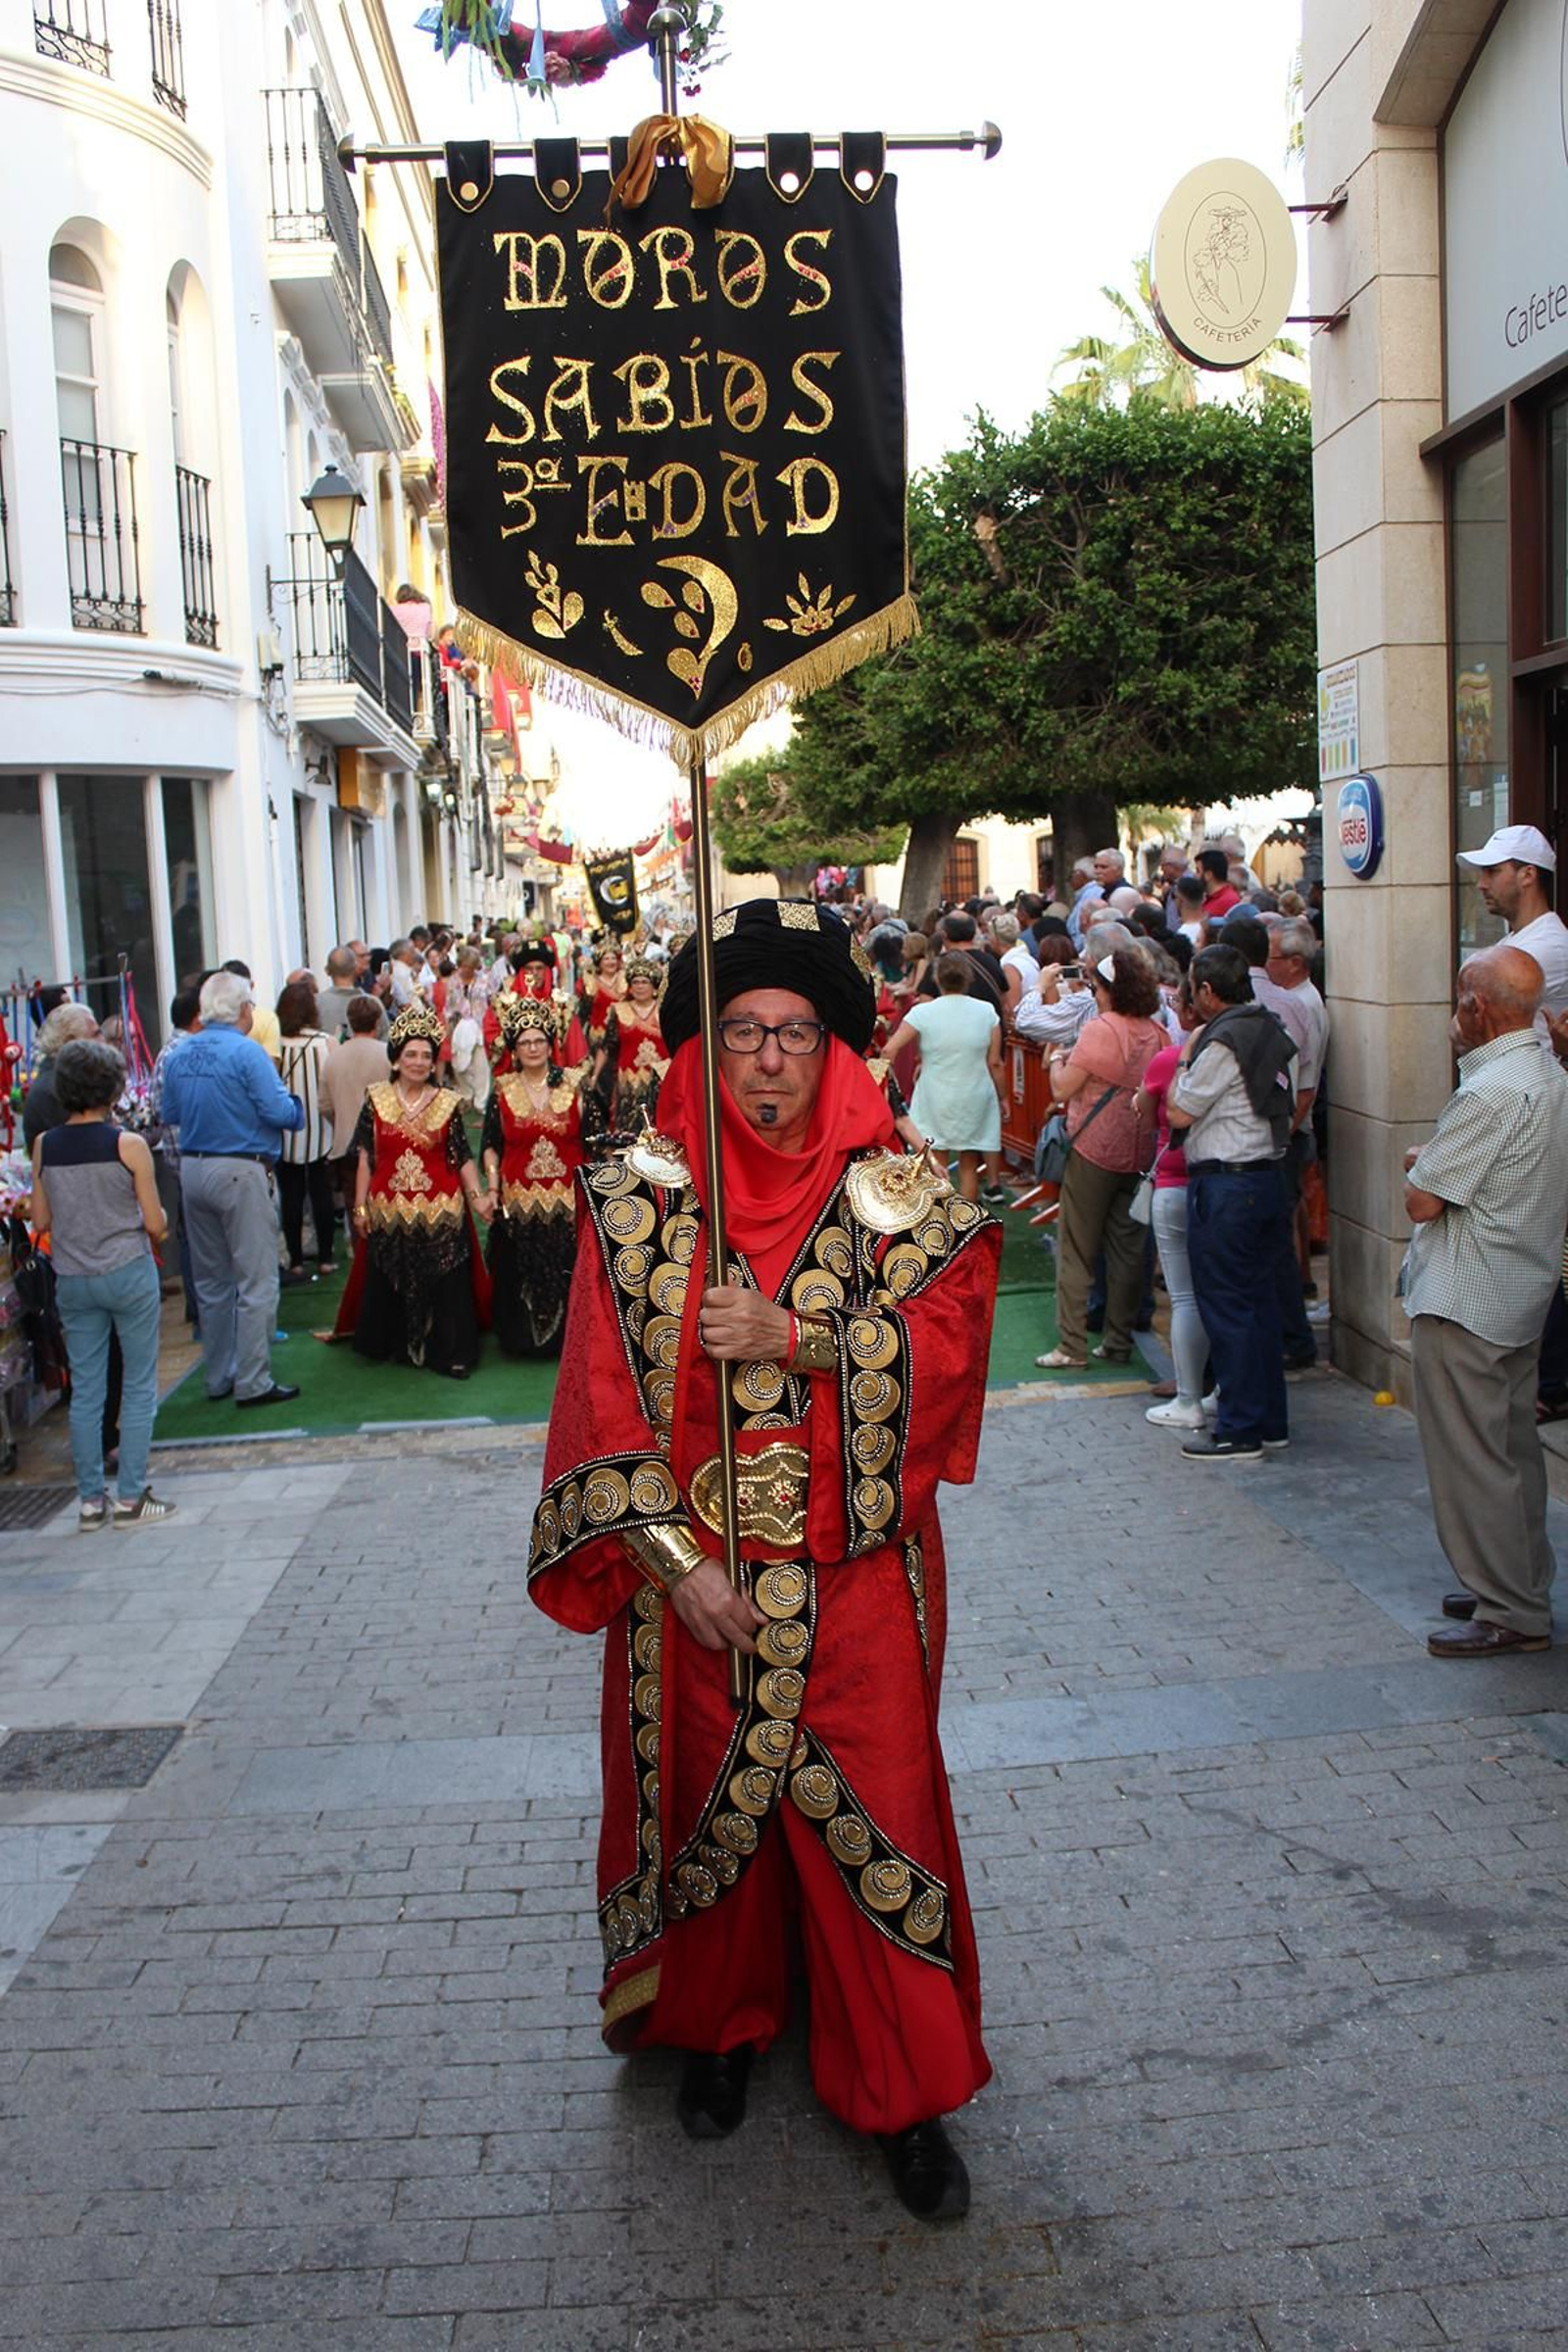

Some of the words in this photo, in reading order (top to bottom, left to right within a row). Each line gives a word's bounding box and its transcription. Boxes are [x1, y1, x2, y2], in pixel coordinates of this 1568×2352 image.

[493, 226, 833, 316] MOROS
[1505, 283, 1568, 347] Cafete
[484, 336, 843, 446] SABÍOS
